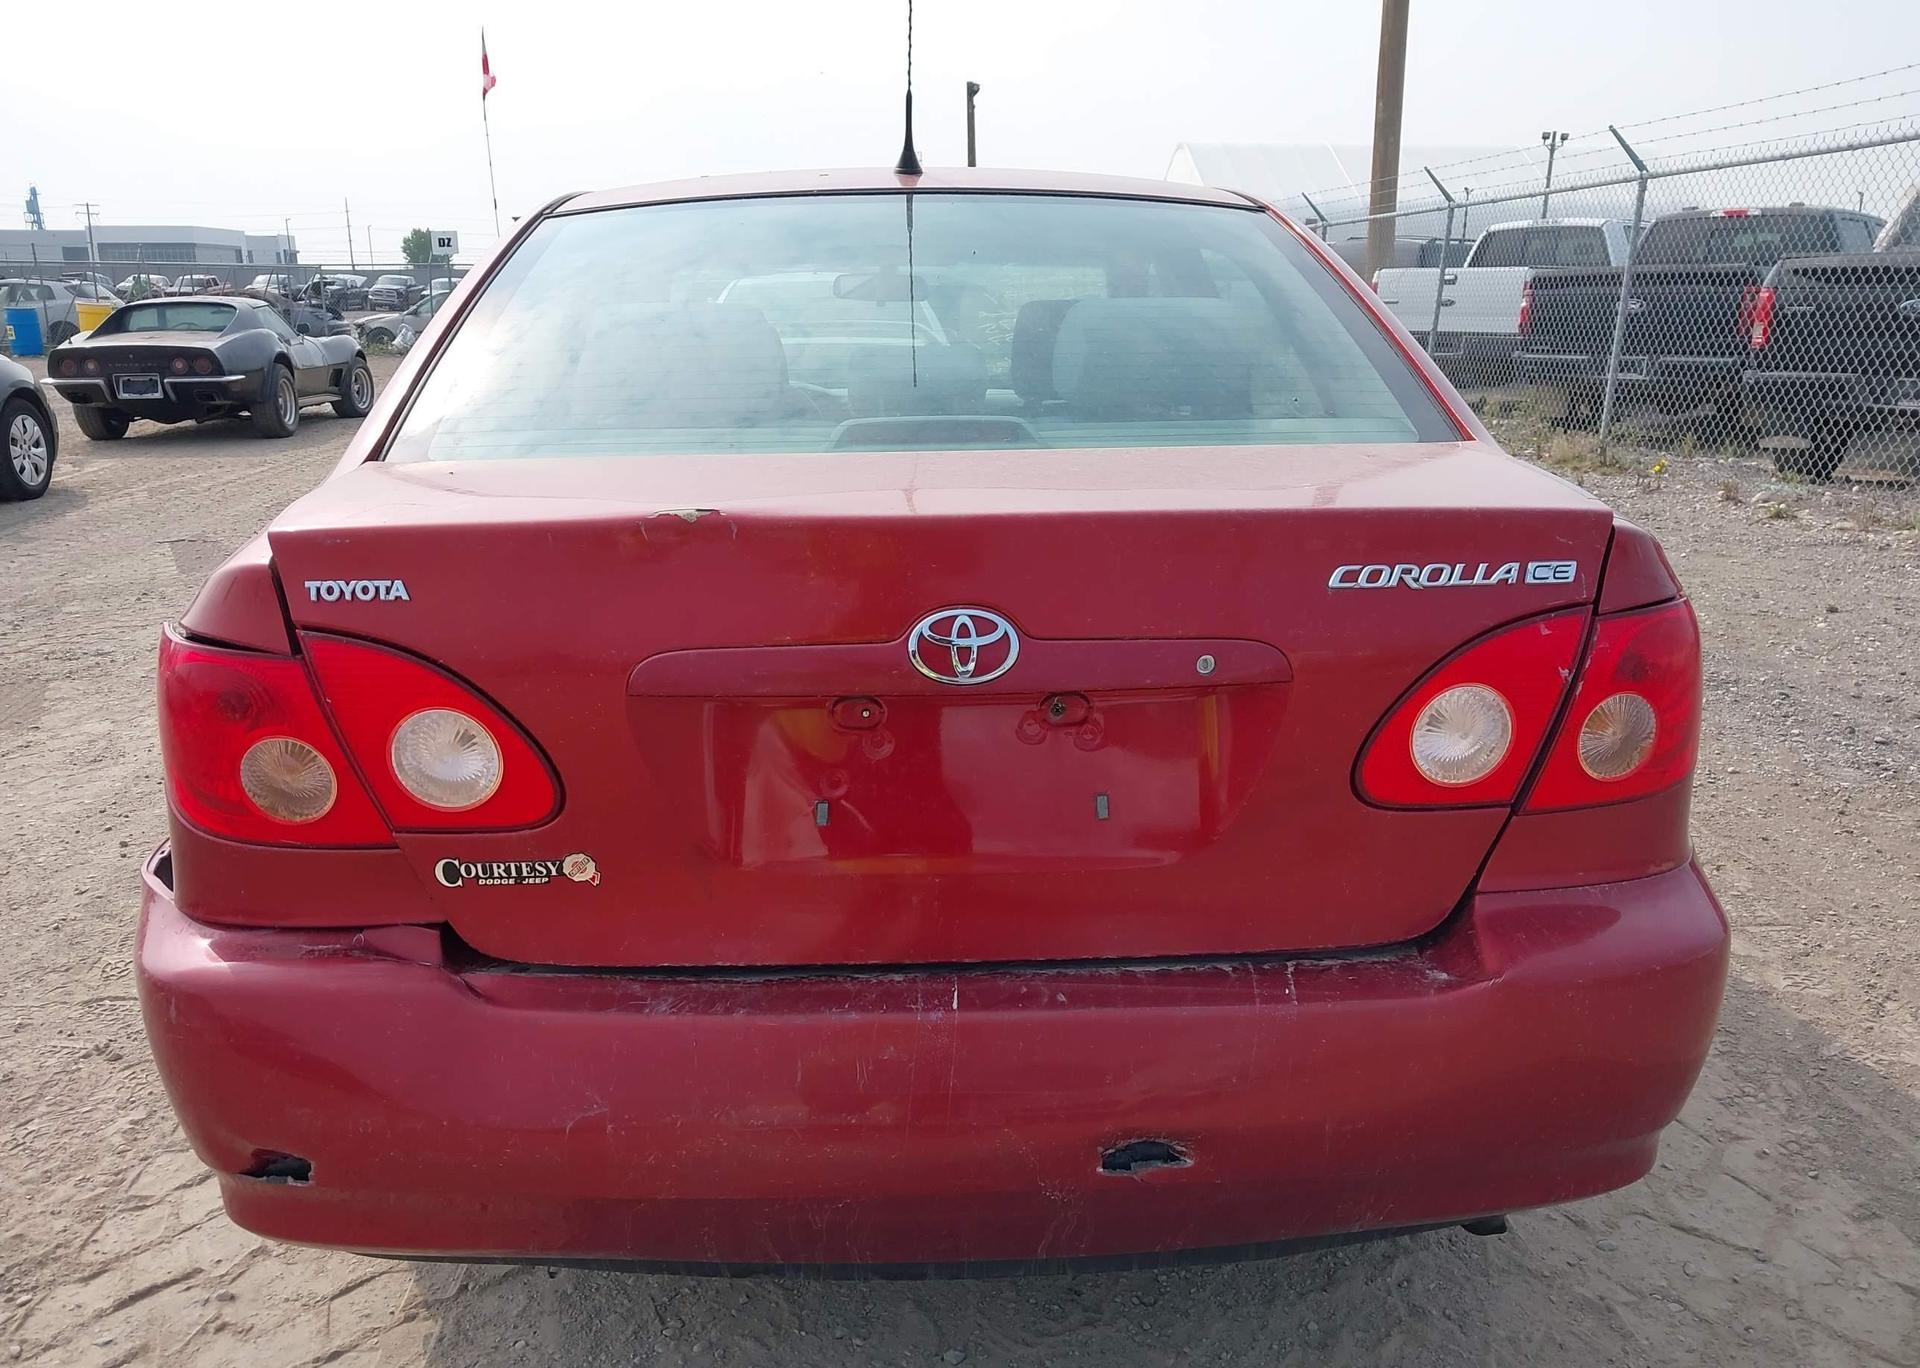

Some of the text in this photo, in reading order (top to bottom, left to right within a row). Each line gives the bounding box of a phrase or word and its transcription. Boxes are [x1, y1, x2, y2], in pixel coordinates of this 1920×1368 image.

[438, 237, 453, 248] DZ
[1327, 561, 1573, 589] COROLLA CE
[304, 579, 411, 603] TOYOTA
